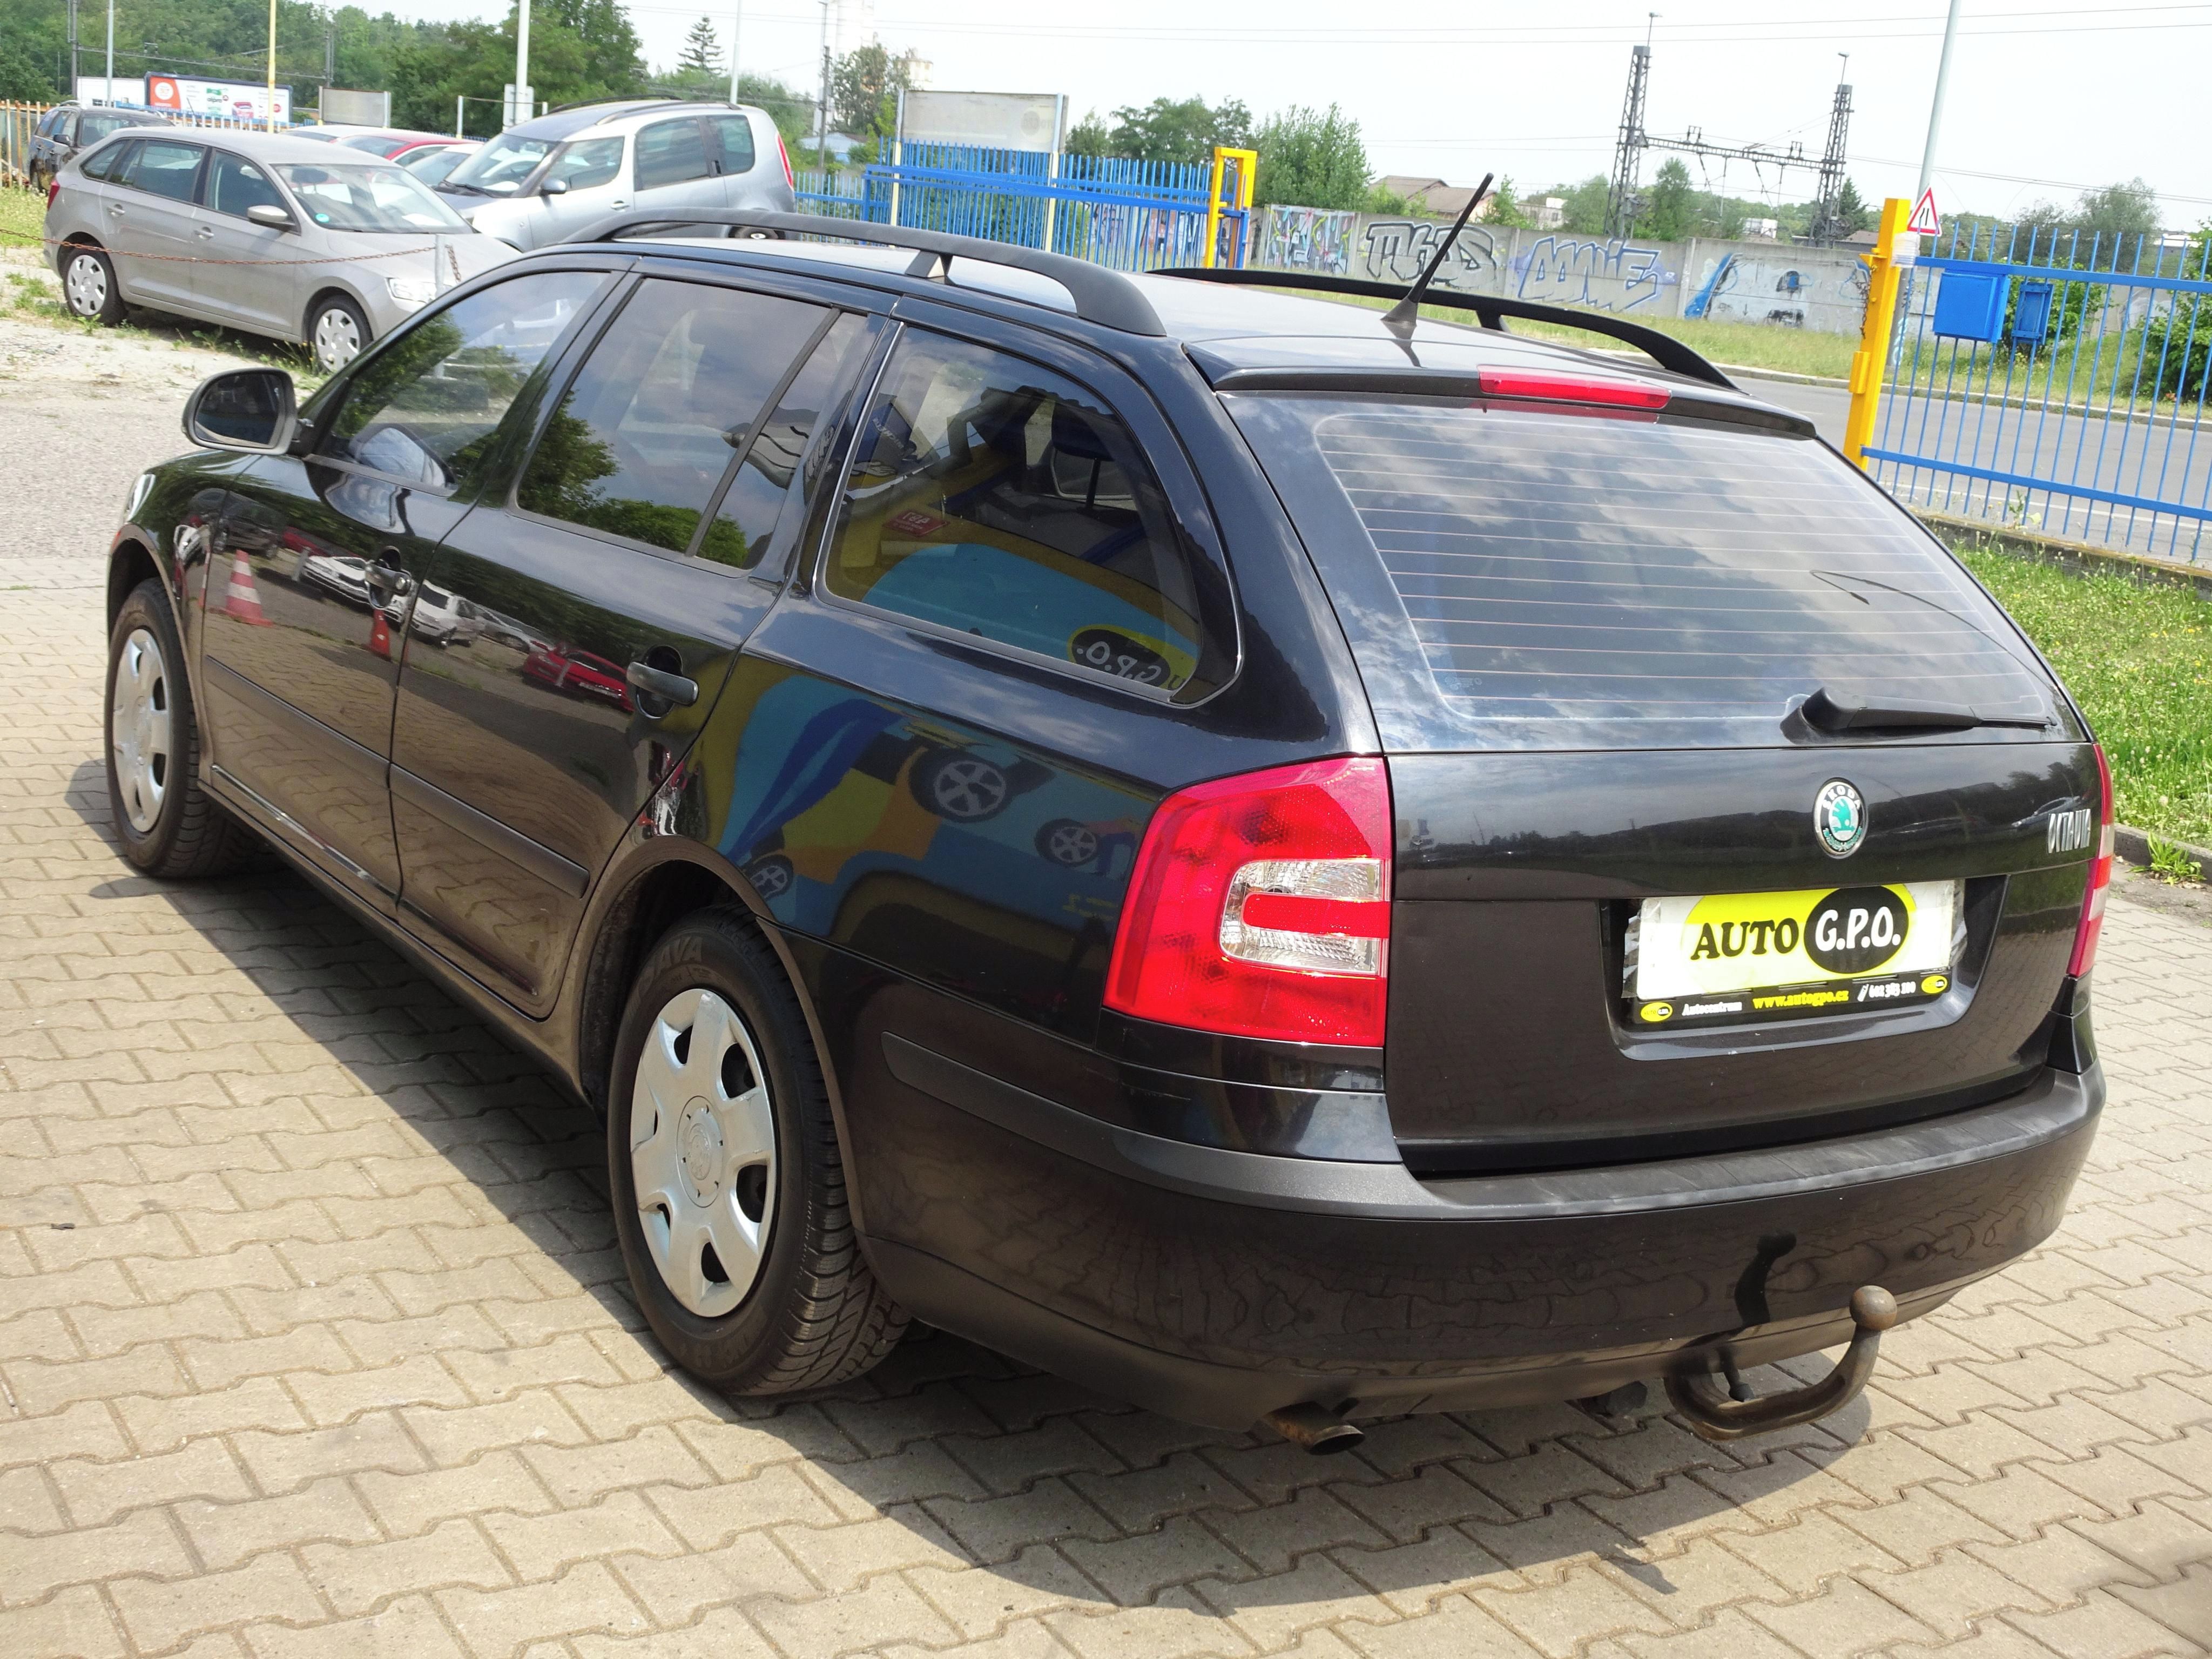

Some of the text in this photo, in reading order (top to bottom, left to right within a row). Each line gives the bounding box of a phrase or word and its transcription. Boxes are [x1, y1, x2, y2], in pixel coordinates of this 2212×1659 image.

[1690, 907, 1901, 960] AUTO G.P.O.
[1752, 990, 1849, 1009] www.autogpo.cz
